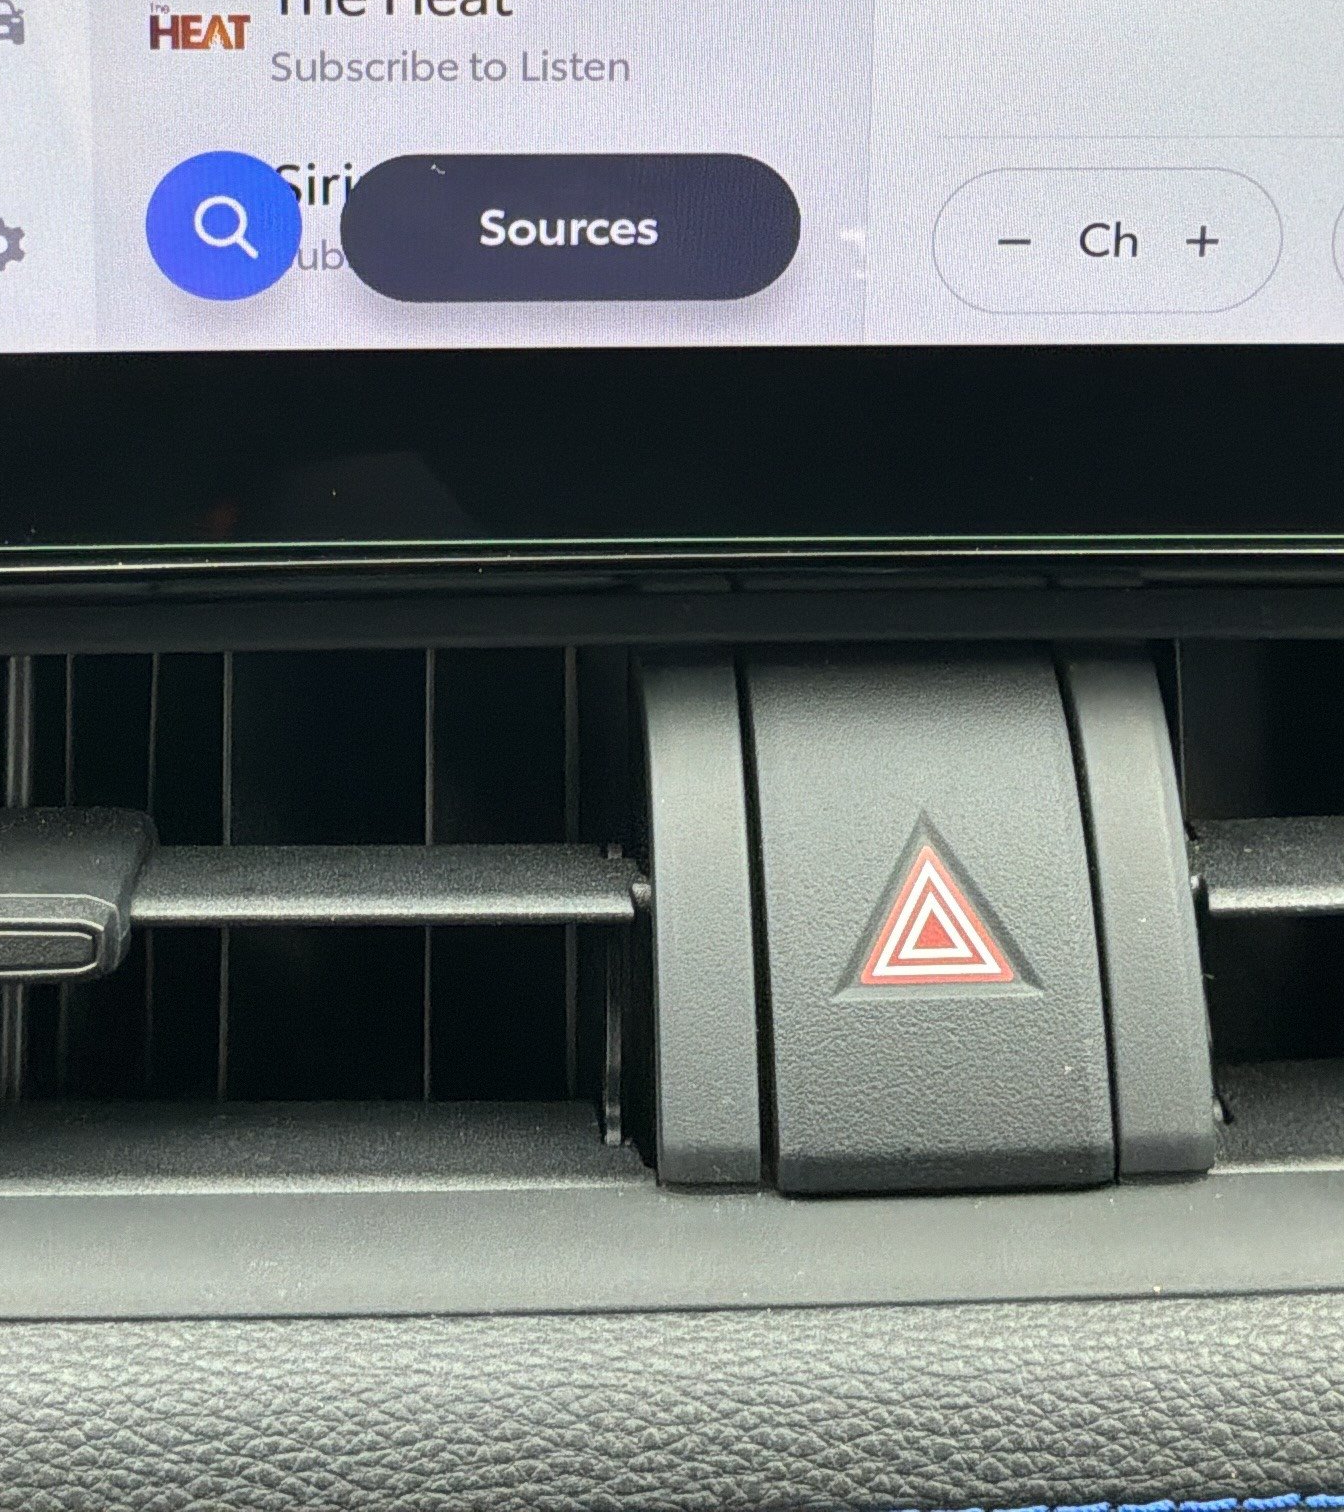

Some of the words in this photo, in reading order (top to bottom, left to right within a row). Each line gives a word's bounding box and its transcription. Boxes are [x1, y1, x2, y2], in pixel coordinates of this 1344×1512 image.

[149, 14, 251, 50] HEAT
[271, 50, 458, 82] Subscribe
[469, 53, 507, 82] to
[522, 51, 630, 82] Listen
[481, 209, 658, 246] Sources
[1079, 221, 1138, 257] Ch
